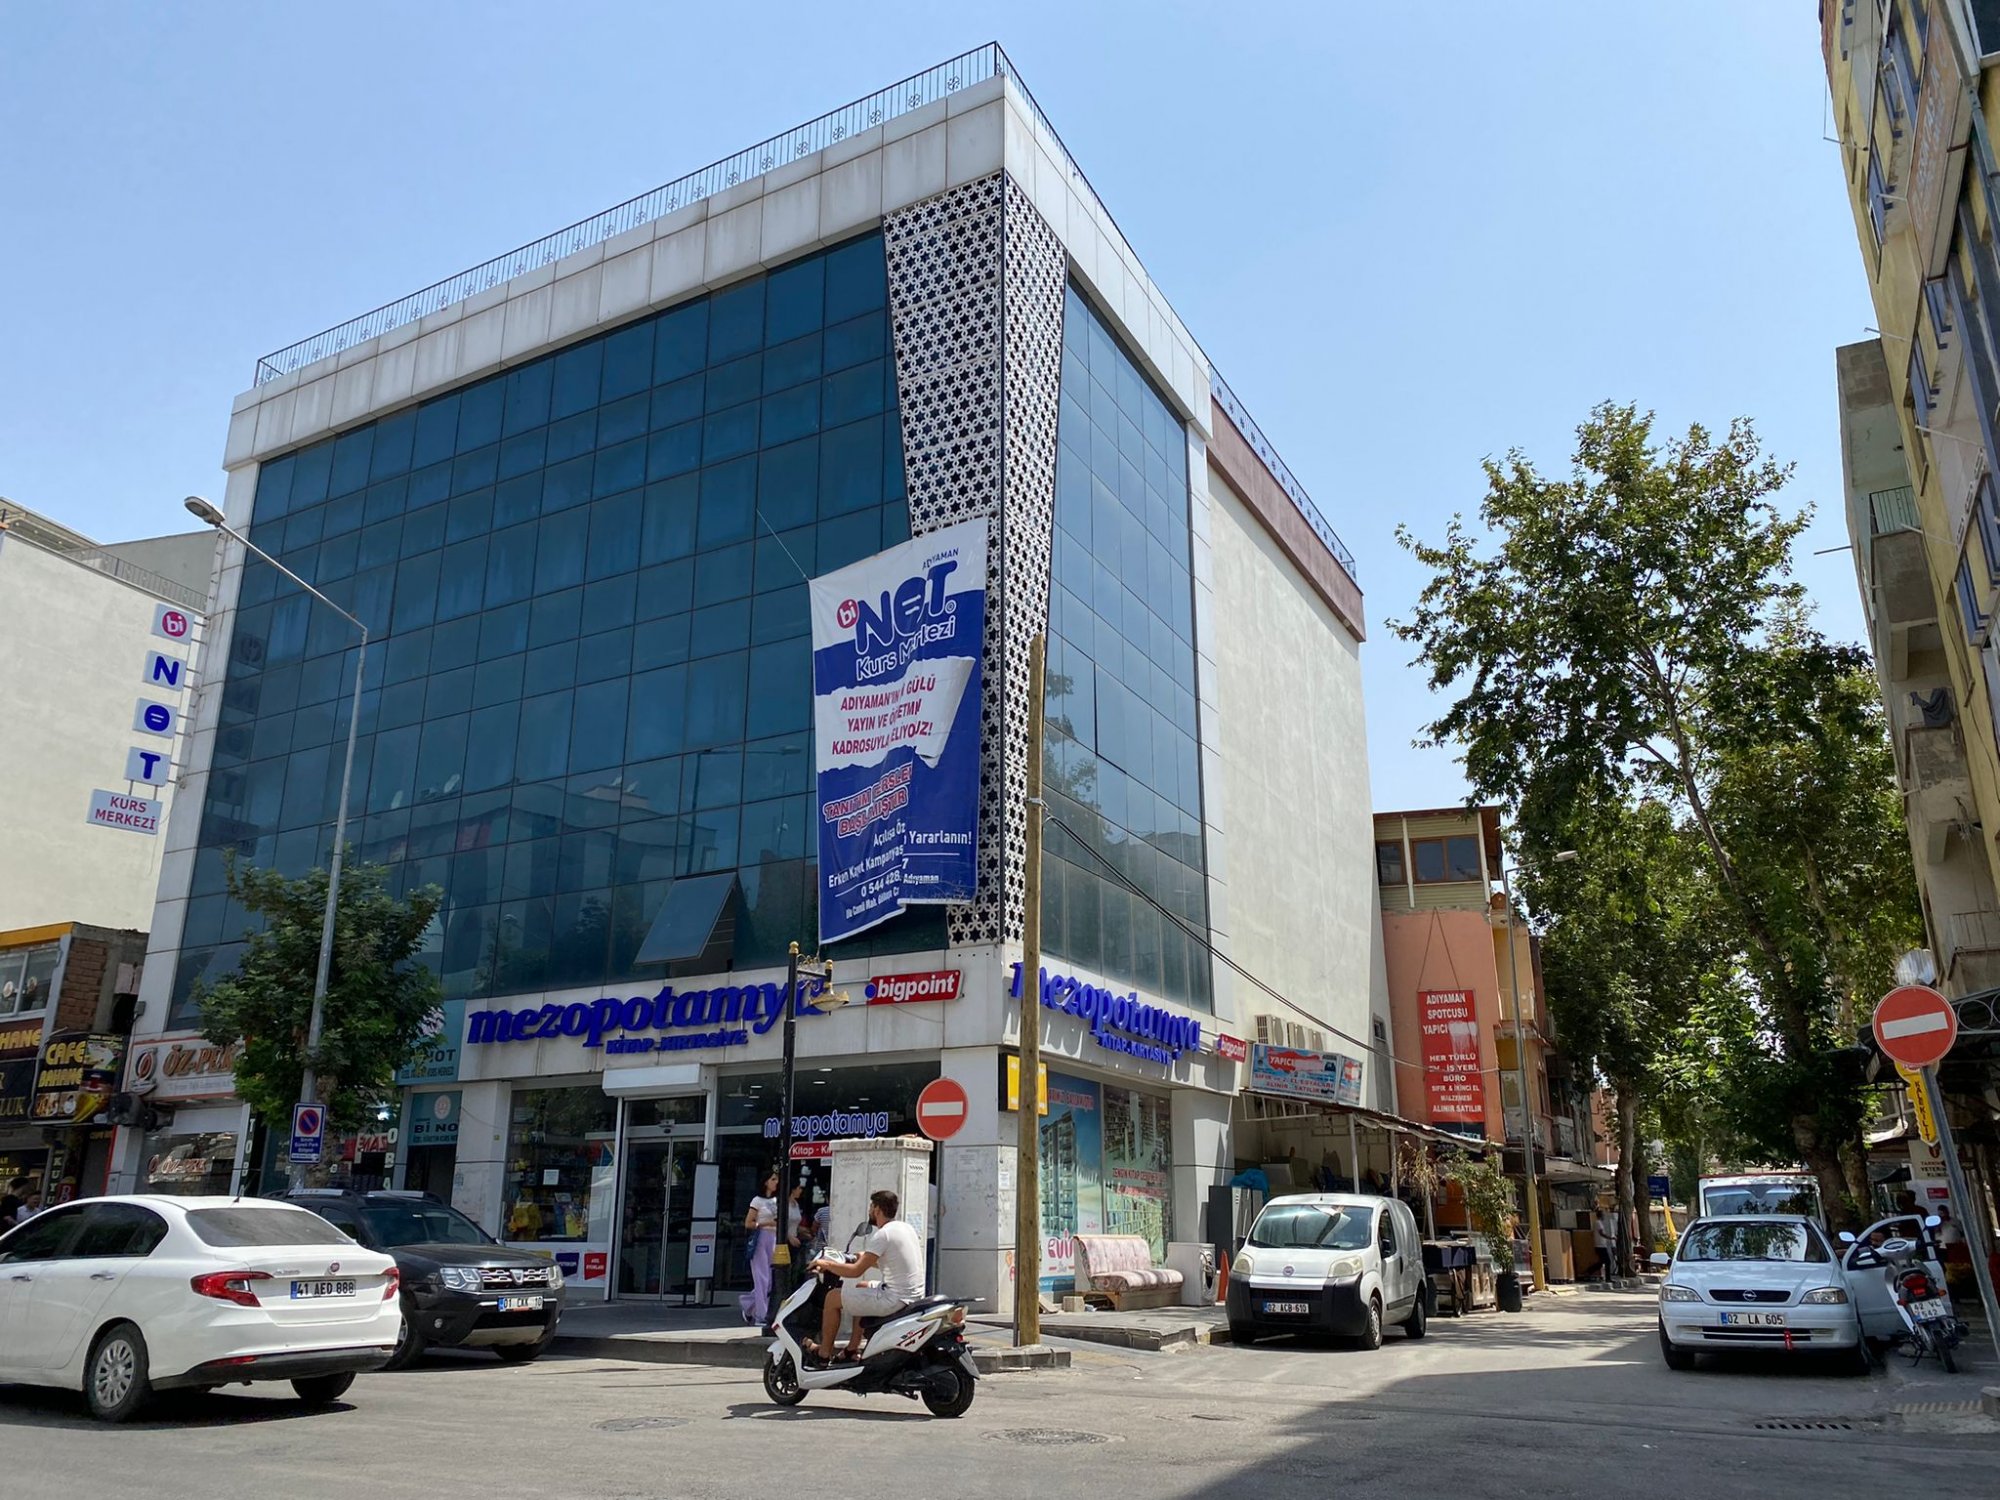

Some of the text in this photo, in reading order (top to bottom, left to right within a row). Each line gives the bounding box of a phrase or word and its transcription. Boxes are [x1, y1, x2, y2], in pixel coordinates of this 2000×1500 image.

[922, 547, 959, 570] ADIYAMAN
[856, 651, 897, 681] Kurs
[847, 716, 875, 732] YAYIN
[878, 713, 889, 728] VE
[110, 796, 147, 813] KURS
[95, 808, 156, 830] MERKEZİ
[909, 830, 972, 845] Yararlanın!
[828, 869, 850, 888] Erken
[903, 873, 939, 885] Adıyaman
[861, 885, 867, 897] 0
[868, 877, 884, 894] 544
[877, 975, 956, 1004] bigpoint
[1426, 993, 1466, 1004] ADIYAMAN
[1427, 1008, 1468, 1020] SPOTCUSU
[1423, 1025, 1448, 1035] YAPICI
[45, 1040, 87, 1065] CAFE
[1448, 1053, 1476, 1061] TÜRLÜ
[1443, 1074, 1467, 1082] BÜRO
[764, 1109, 888, 1141] mzopotamya
[792, 1145, 814, 1157] Kitap
[296, 1281, 354, 1296] 41 AED 888
[1727, 1314, 1783, 1325] 02 LA 605
